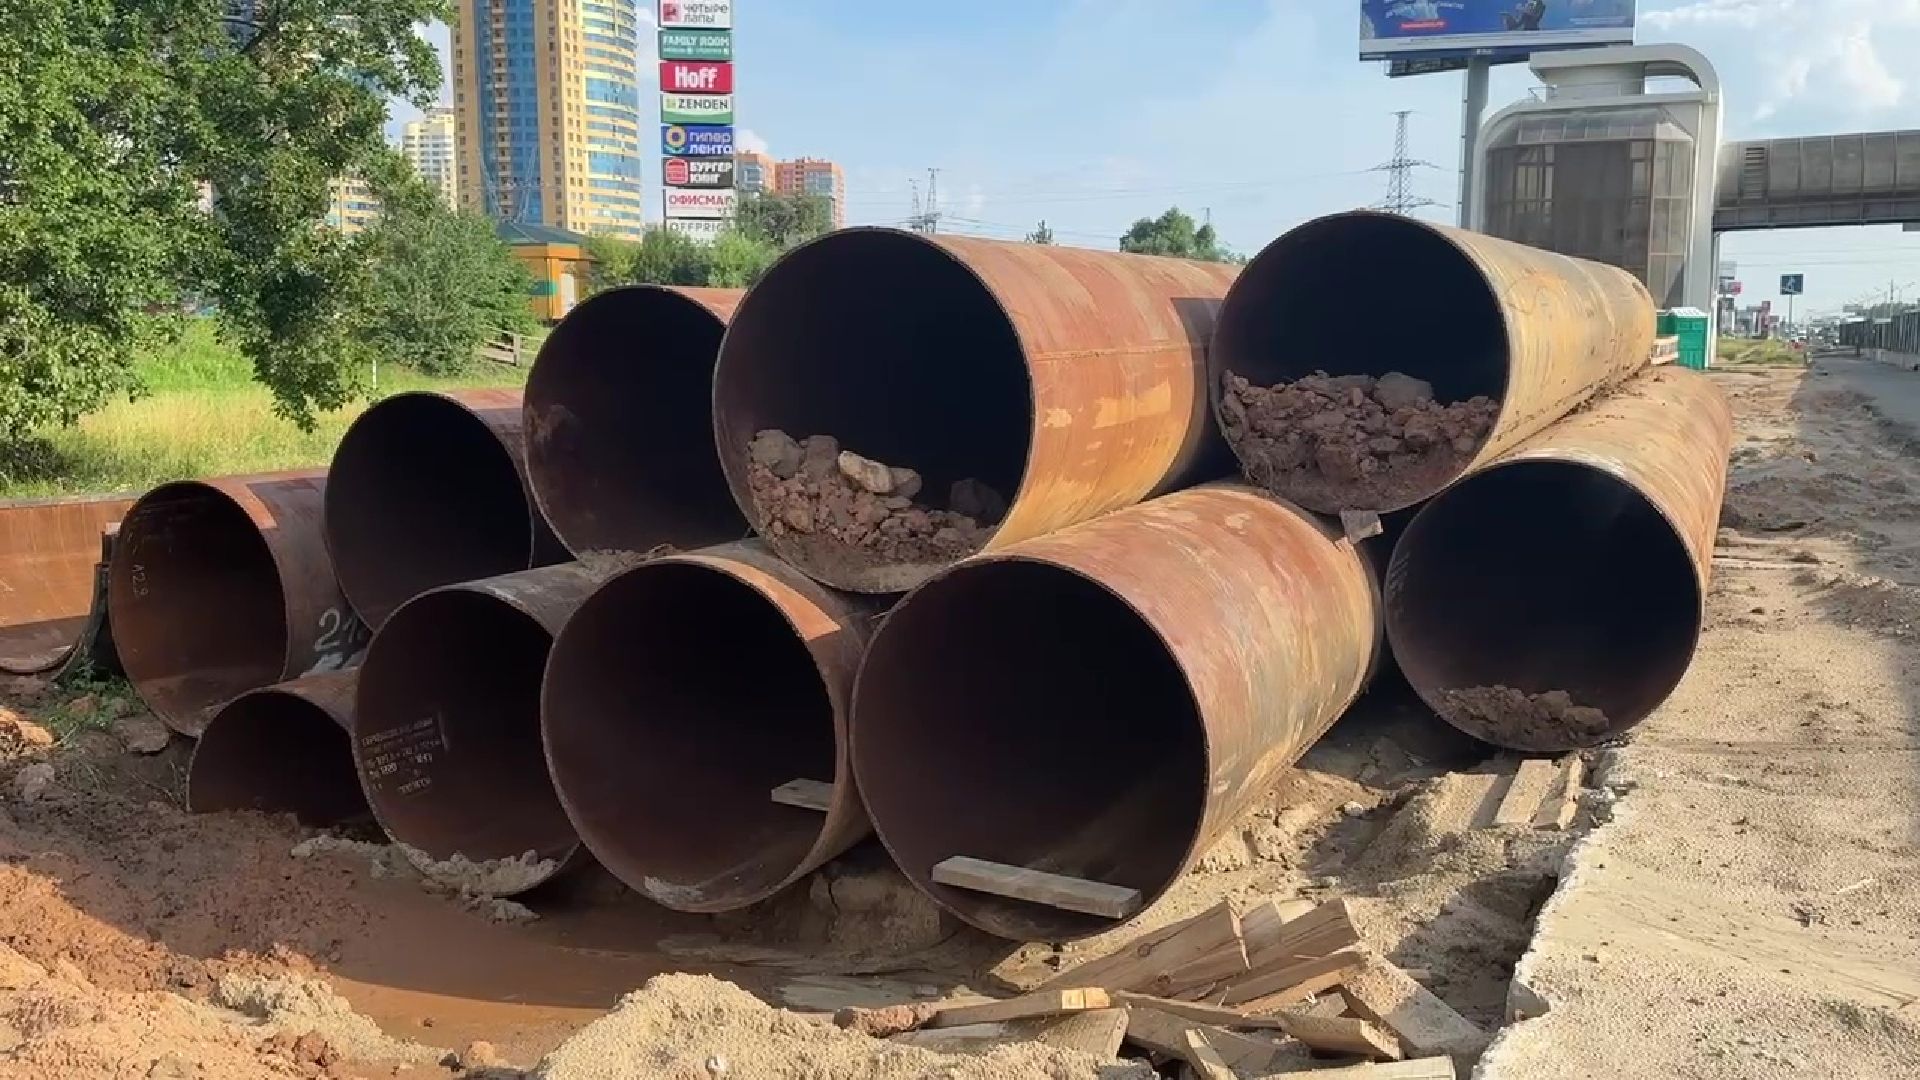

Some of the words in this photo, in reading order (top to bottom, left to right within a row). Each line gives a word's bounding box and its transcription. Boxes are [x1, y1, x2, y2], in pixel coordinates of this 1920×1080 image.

[663, 36, 697, 46] FAMILY
[699, 36, 729, 46] ROOM
[675, 66, 718, 88] Hoff
[678, 99, 728, 110] ZENDEN
[690, 162, 733, 173] БУРГЕР
[690, 174, 720, 184] КИНГ
